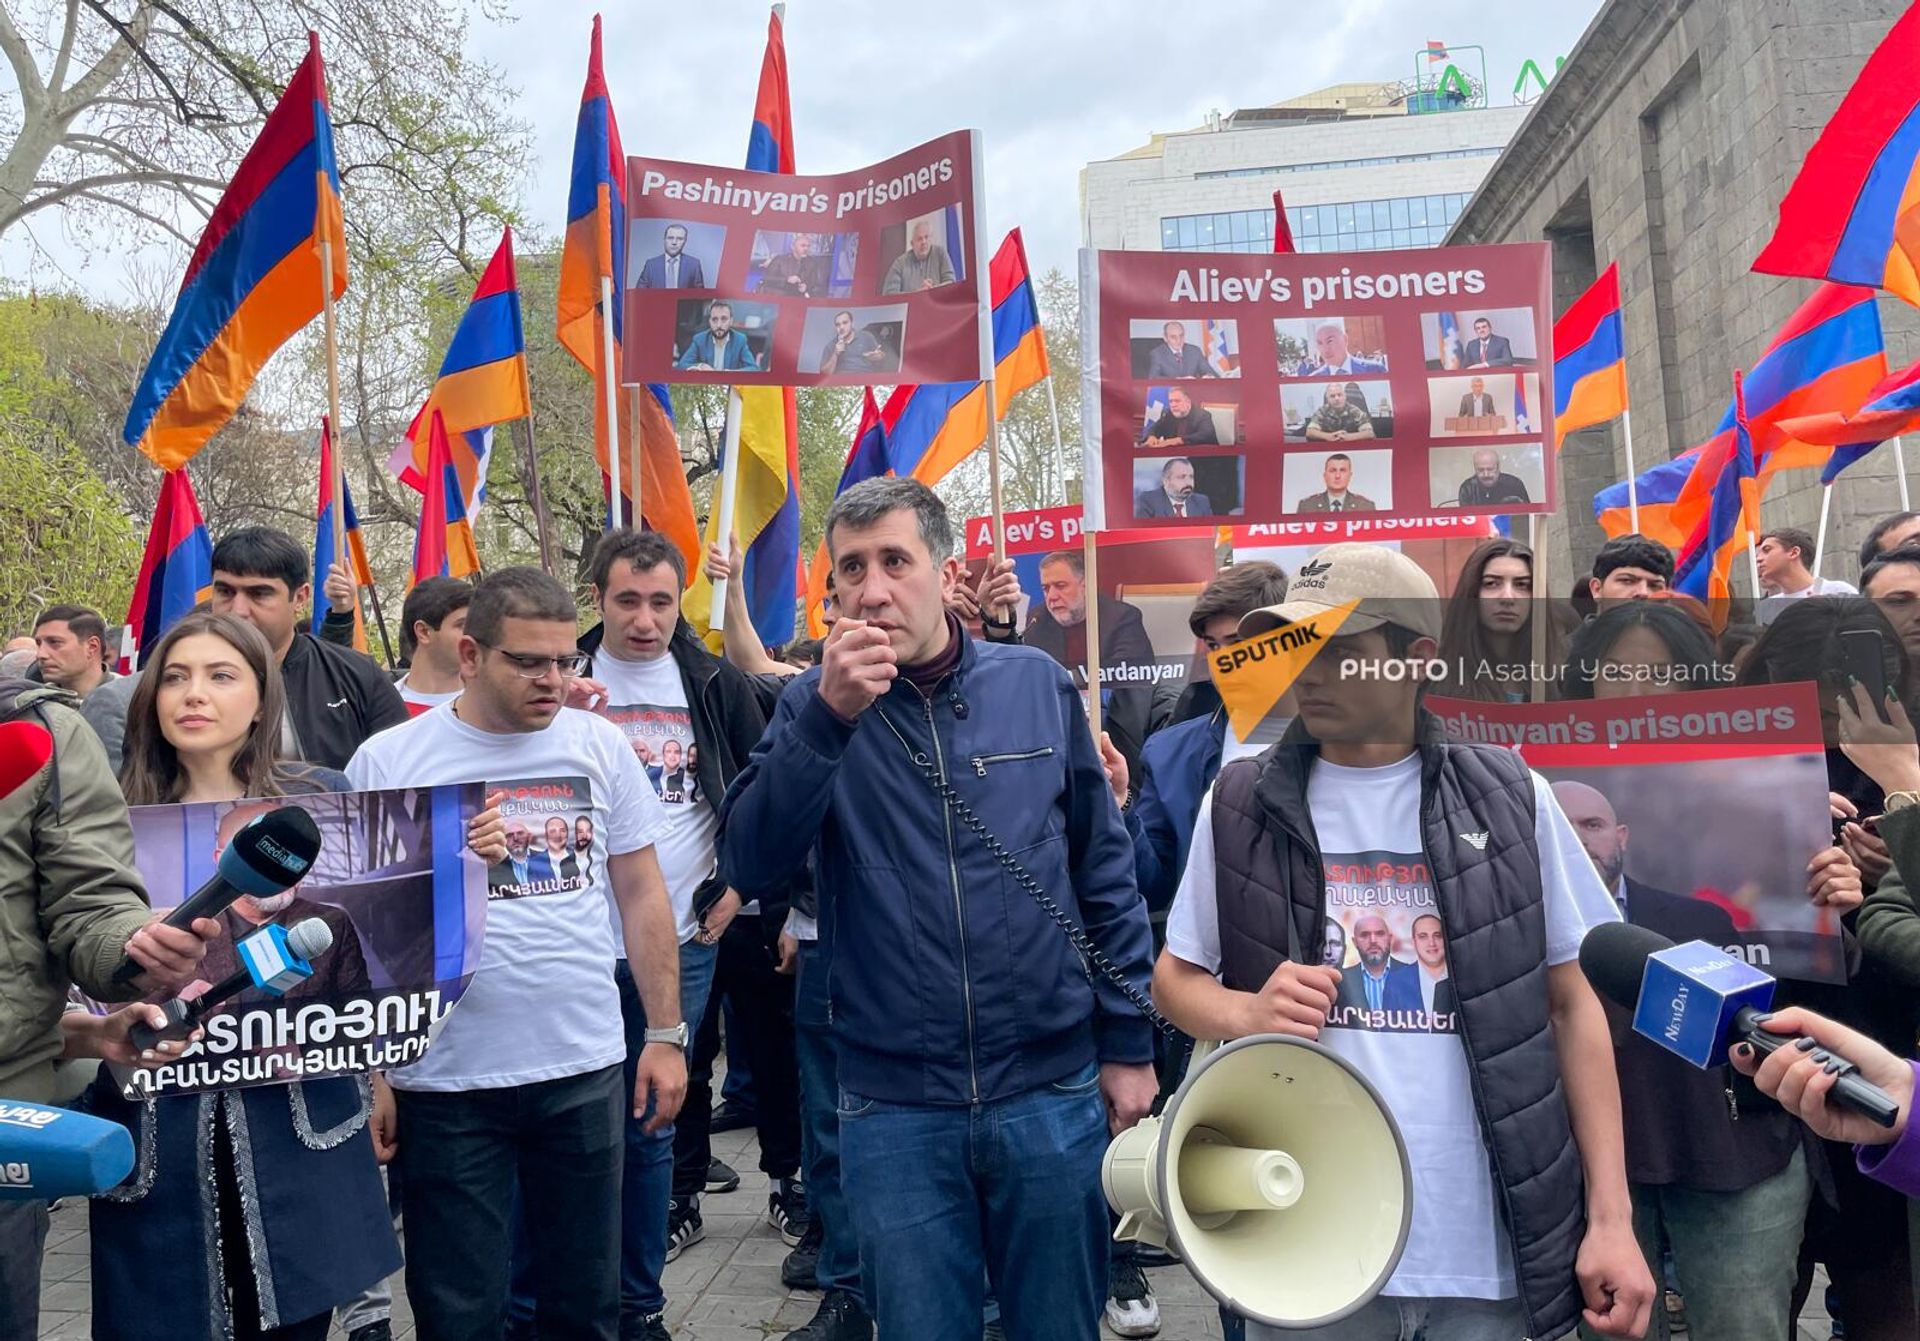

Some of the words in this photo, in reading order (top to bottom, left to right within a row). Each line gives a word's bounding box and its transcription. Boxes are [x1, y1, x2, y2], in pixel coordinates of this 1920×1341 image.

[641, 170, 829, 217] Pashinyan's
[836, 157, 953, 219] prisoners
[1170, 267, 1291, 303] Aliev's
[1302, 266, 1486, 308] prisoners
[976, 513, 1055, 547] Aev's
[1606, 706, 1796, 749] prisoners
[181, 990, 453, 1058] ՏՈՒԹՅՈՒՆ
